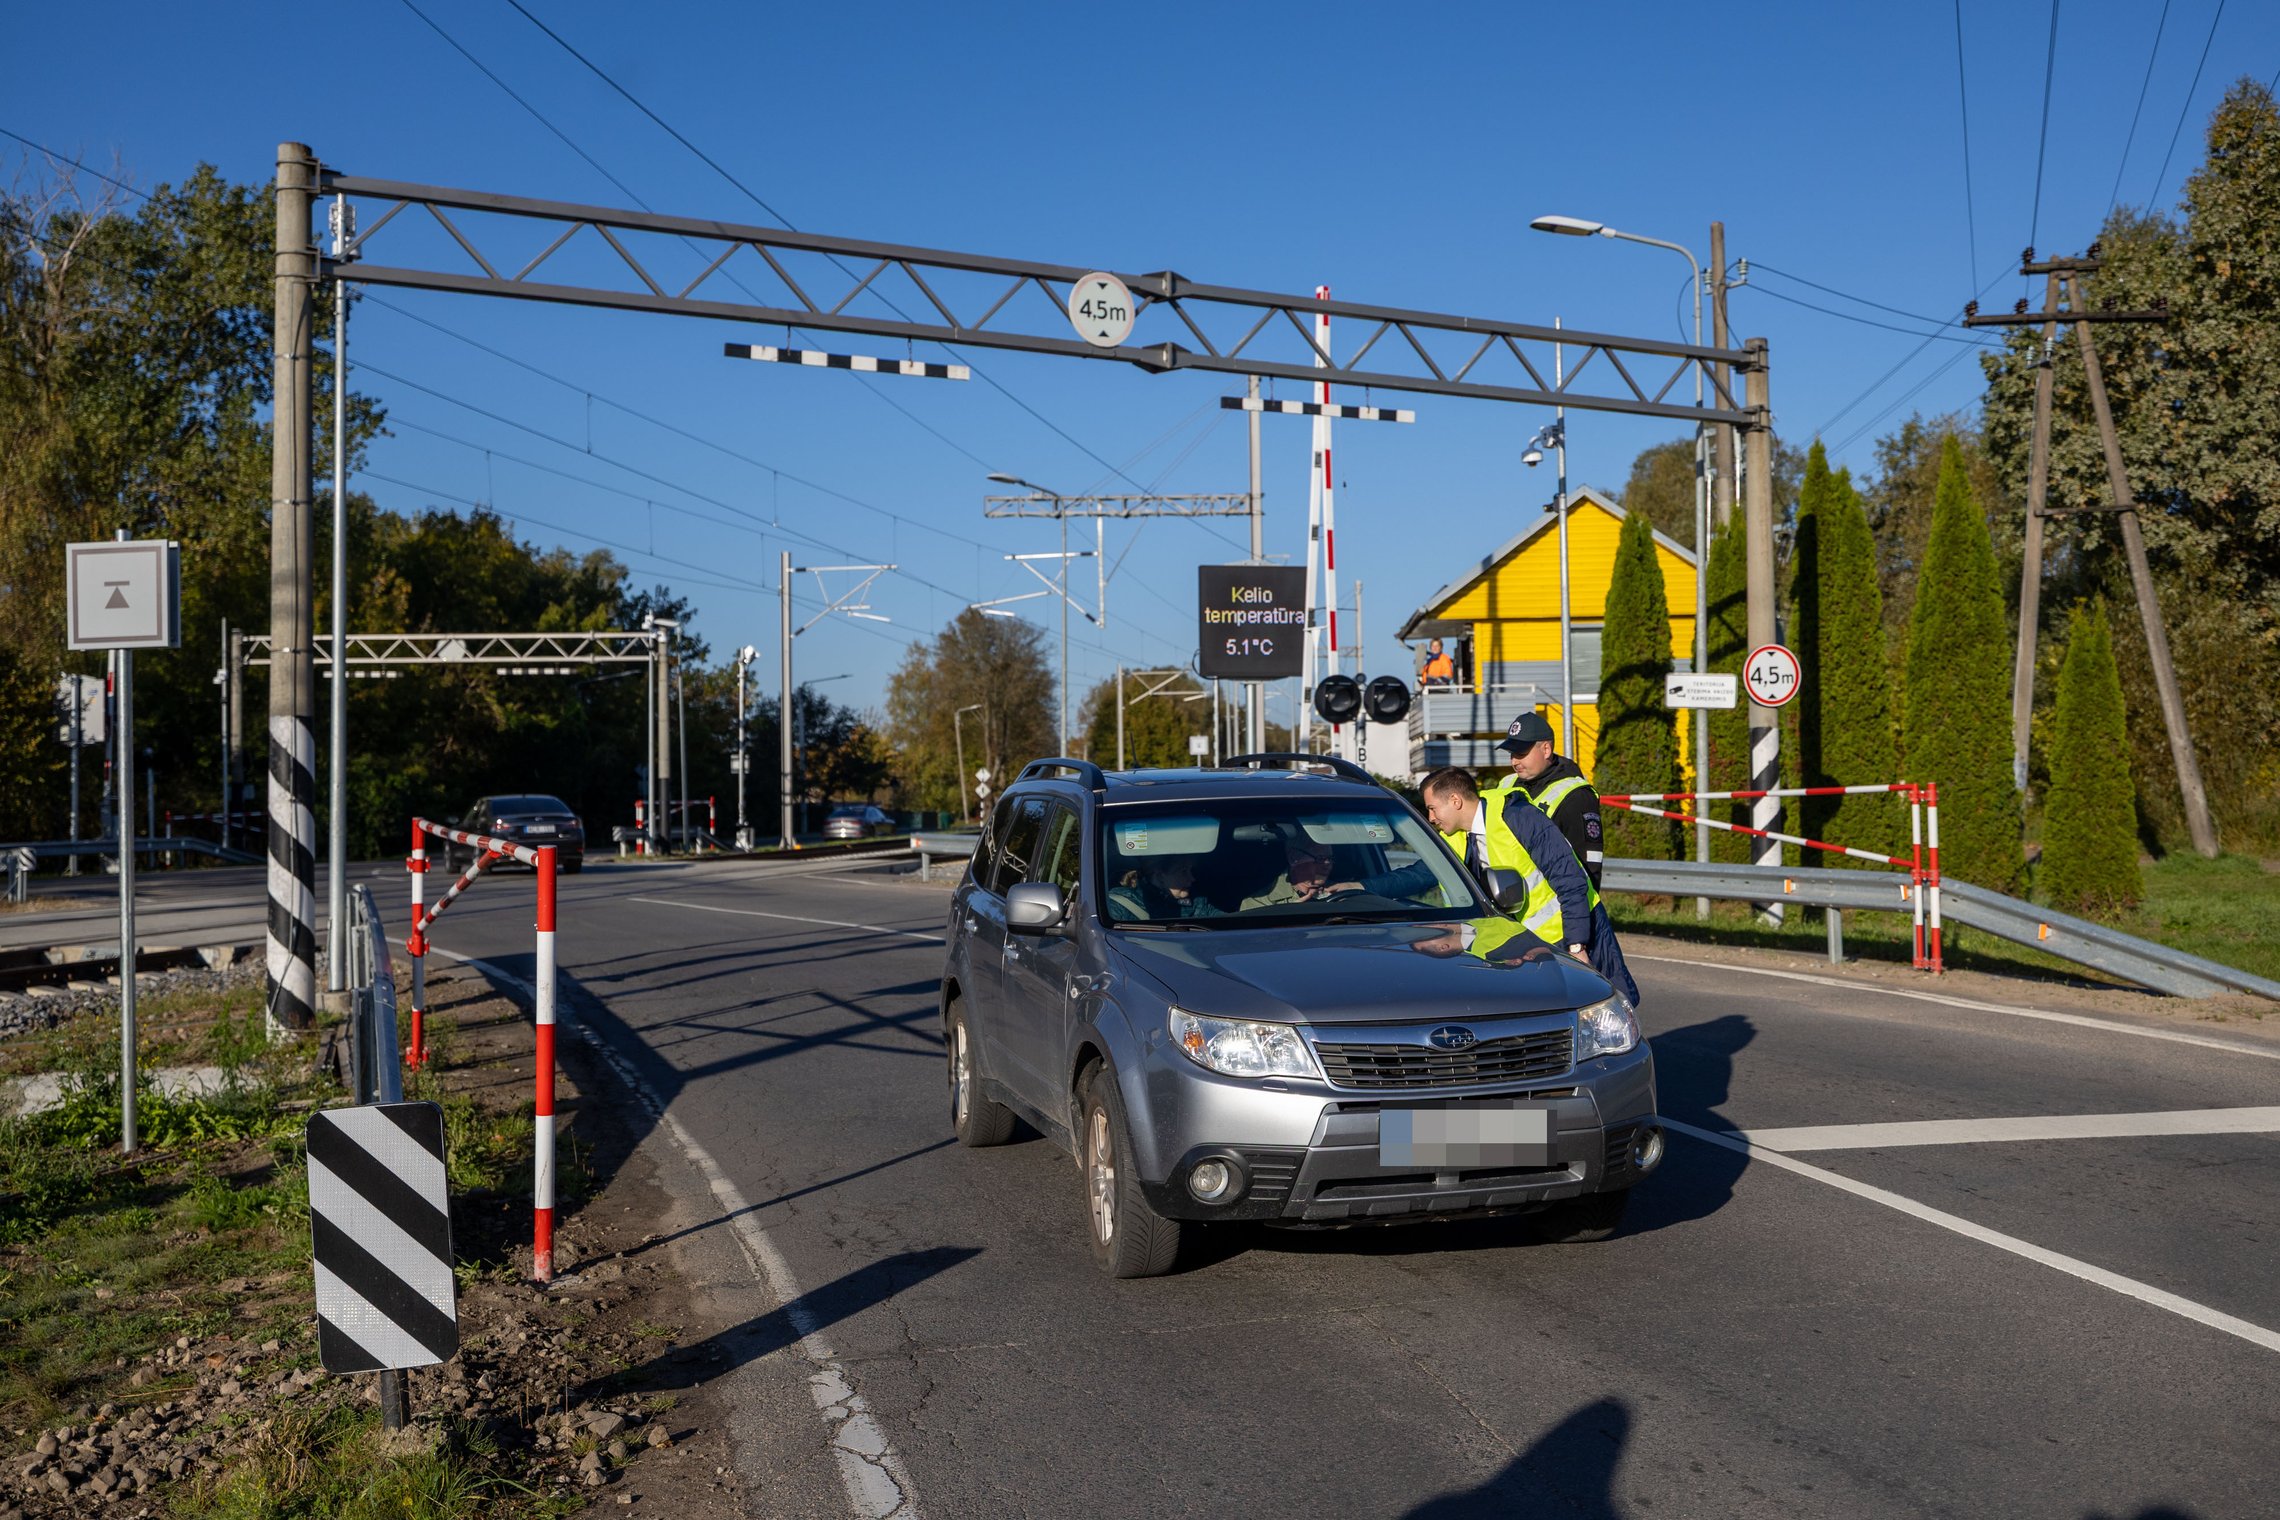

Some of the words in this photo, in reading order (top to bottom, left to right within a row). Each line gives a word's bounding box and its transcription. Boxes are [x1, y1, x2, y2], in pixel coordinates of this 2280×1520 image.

[1079, 299, 1126, 322] 4,5m
[1231, 586, 1273, 603] Kelio
[1204, 607, 1305, 627] temperatūra
[1226, 638, 1274, 656] 5.1°C
[1750, 666, 1794, 687] 4,5m
[1358, 747, 1367, 762] B
